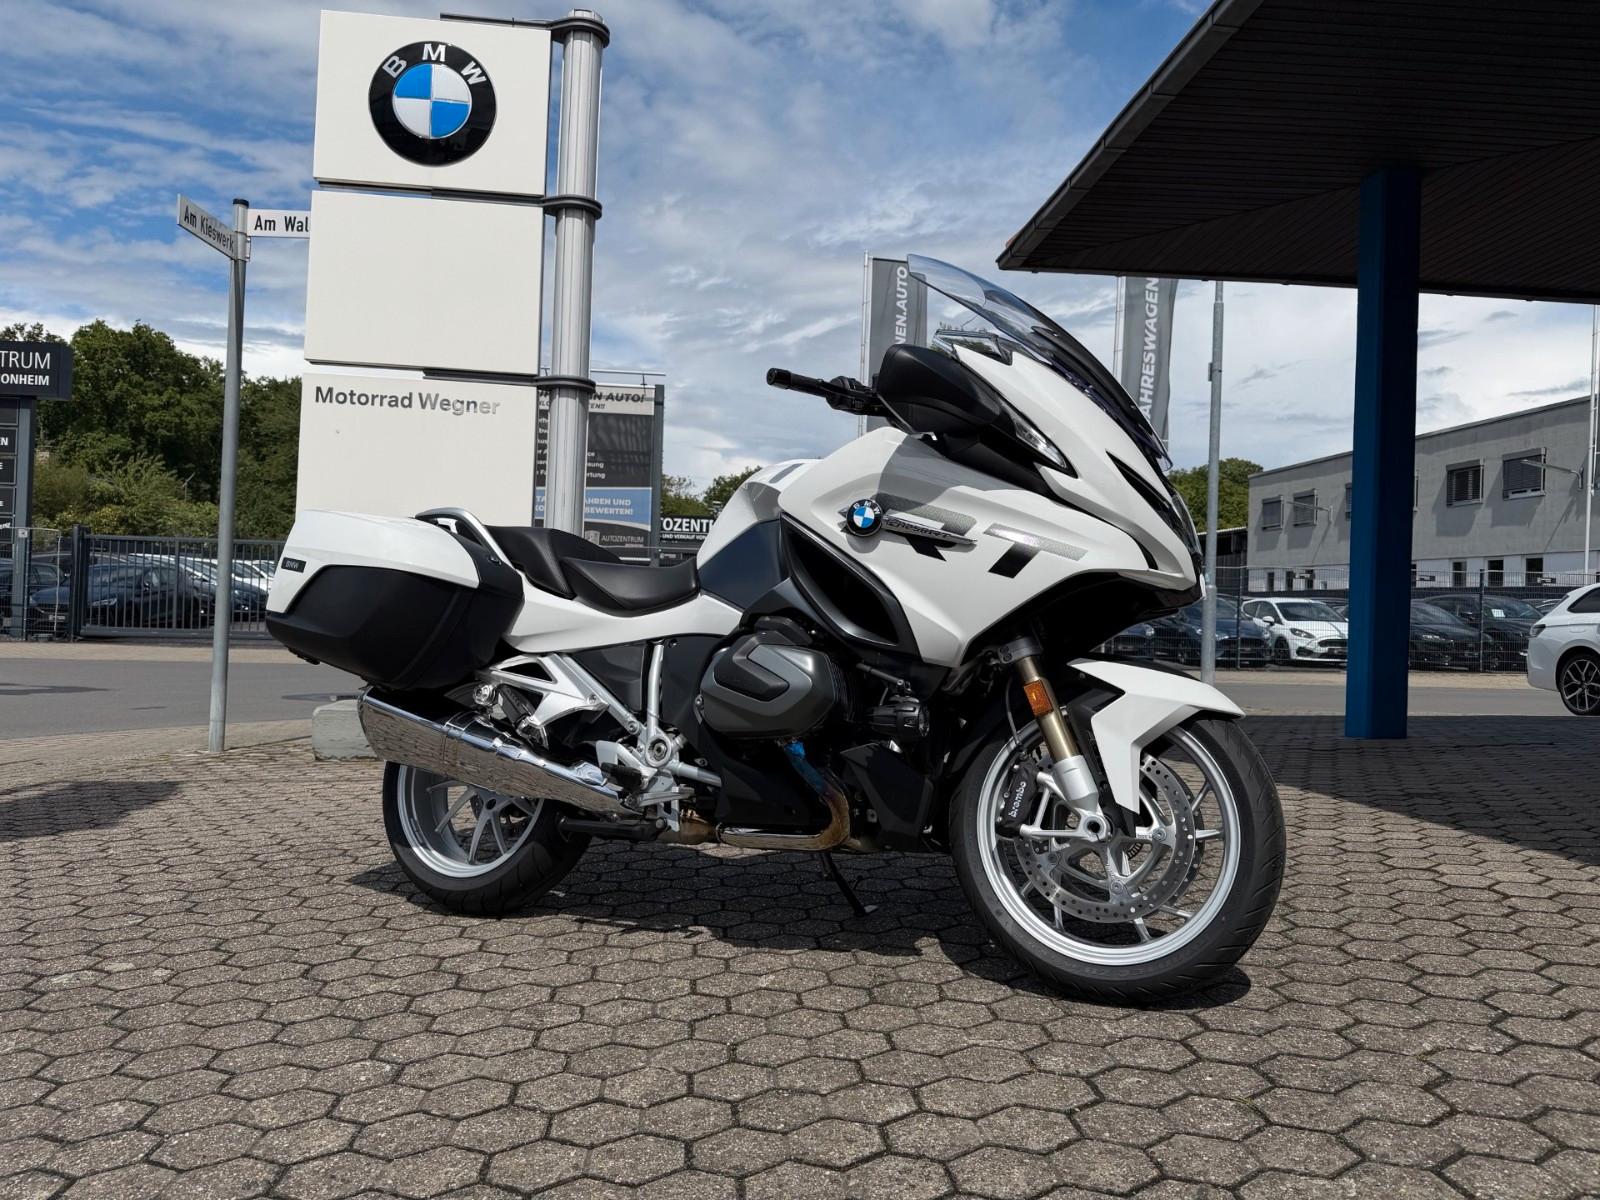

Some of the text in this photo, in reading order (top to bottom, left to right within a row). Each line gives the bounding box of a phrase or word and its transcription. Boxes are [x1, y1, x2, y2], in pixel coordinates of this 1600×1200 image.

[382, 43, 487, 85] BMW
[184, 205, 234, 254] Am Kieswerk
[254, 214, 309, 233] Am Wal
[1138, 277, 1161, 420] AHRESWAGEN
[0, 350, 51, 369] TRUM
[1, 373, 50, 386] ONHEIM
[315, 386, 500, 416] Motorrad Wegner
[605, 392, 645, 403] AUTO!
[852, 500, 881, 515] BMW
[660, 517, 713, 532] OZENT
[1007, 781, 1027, 818] brembo
